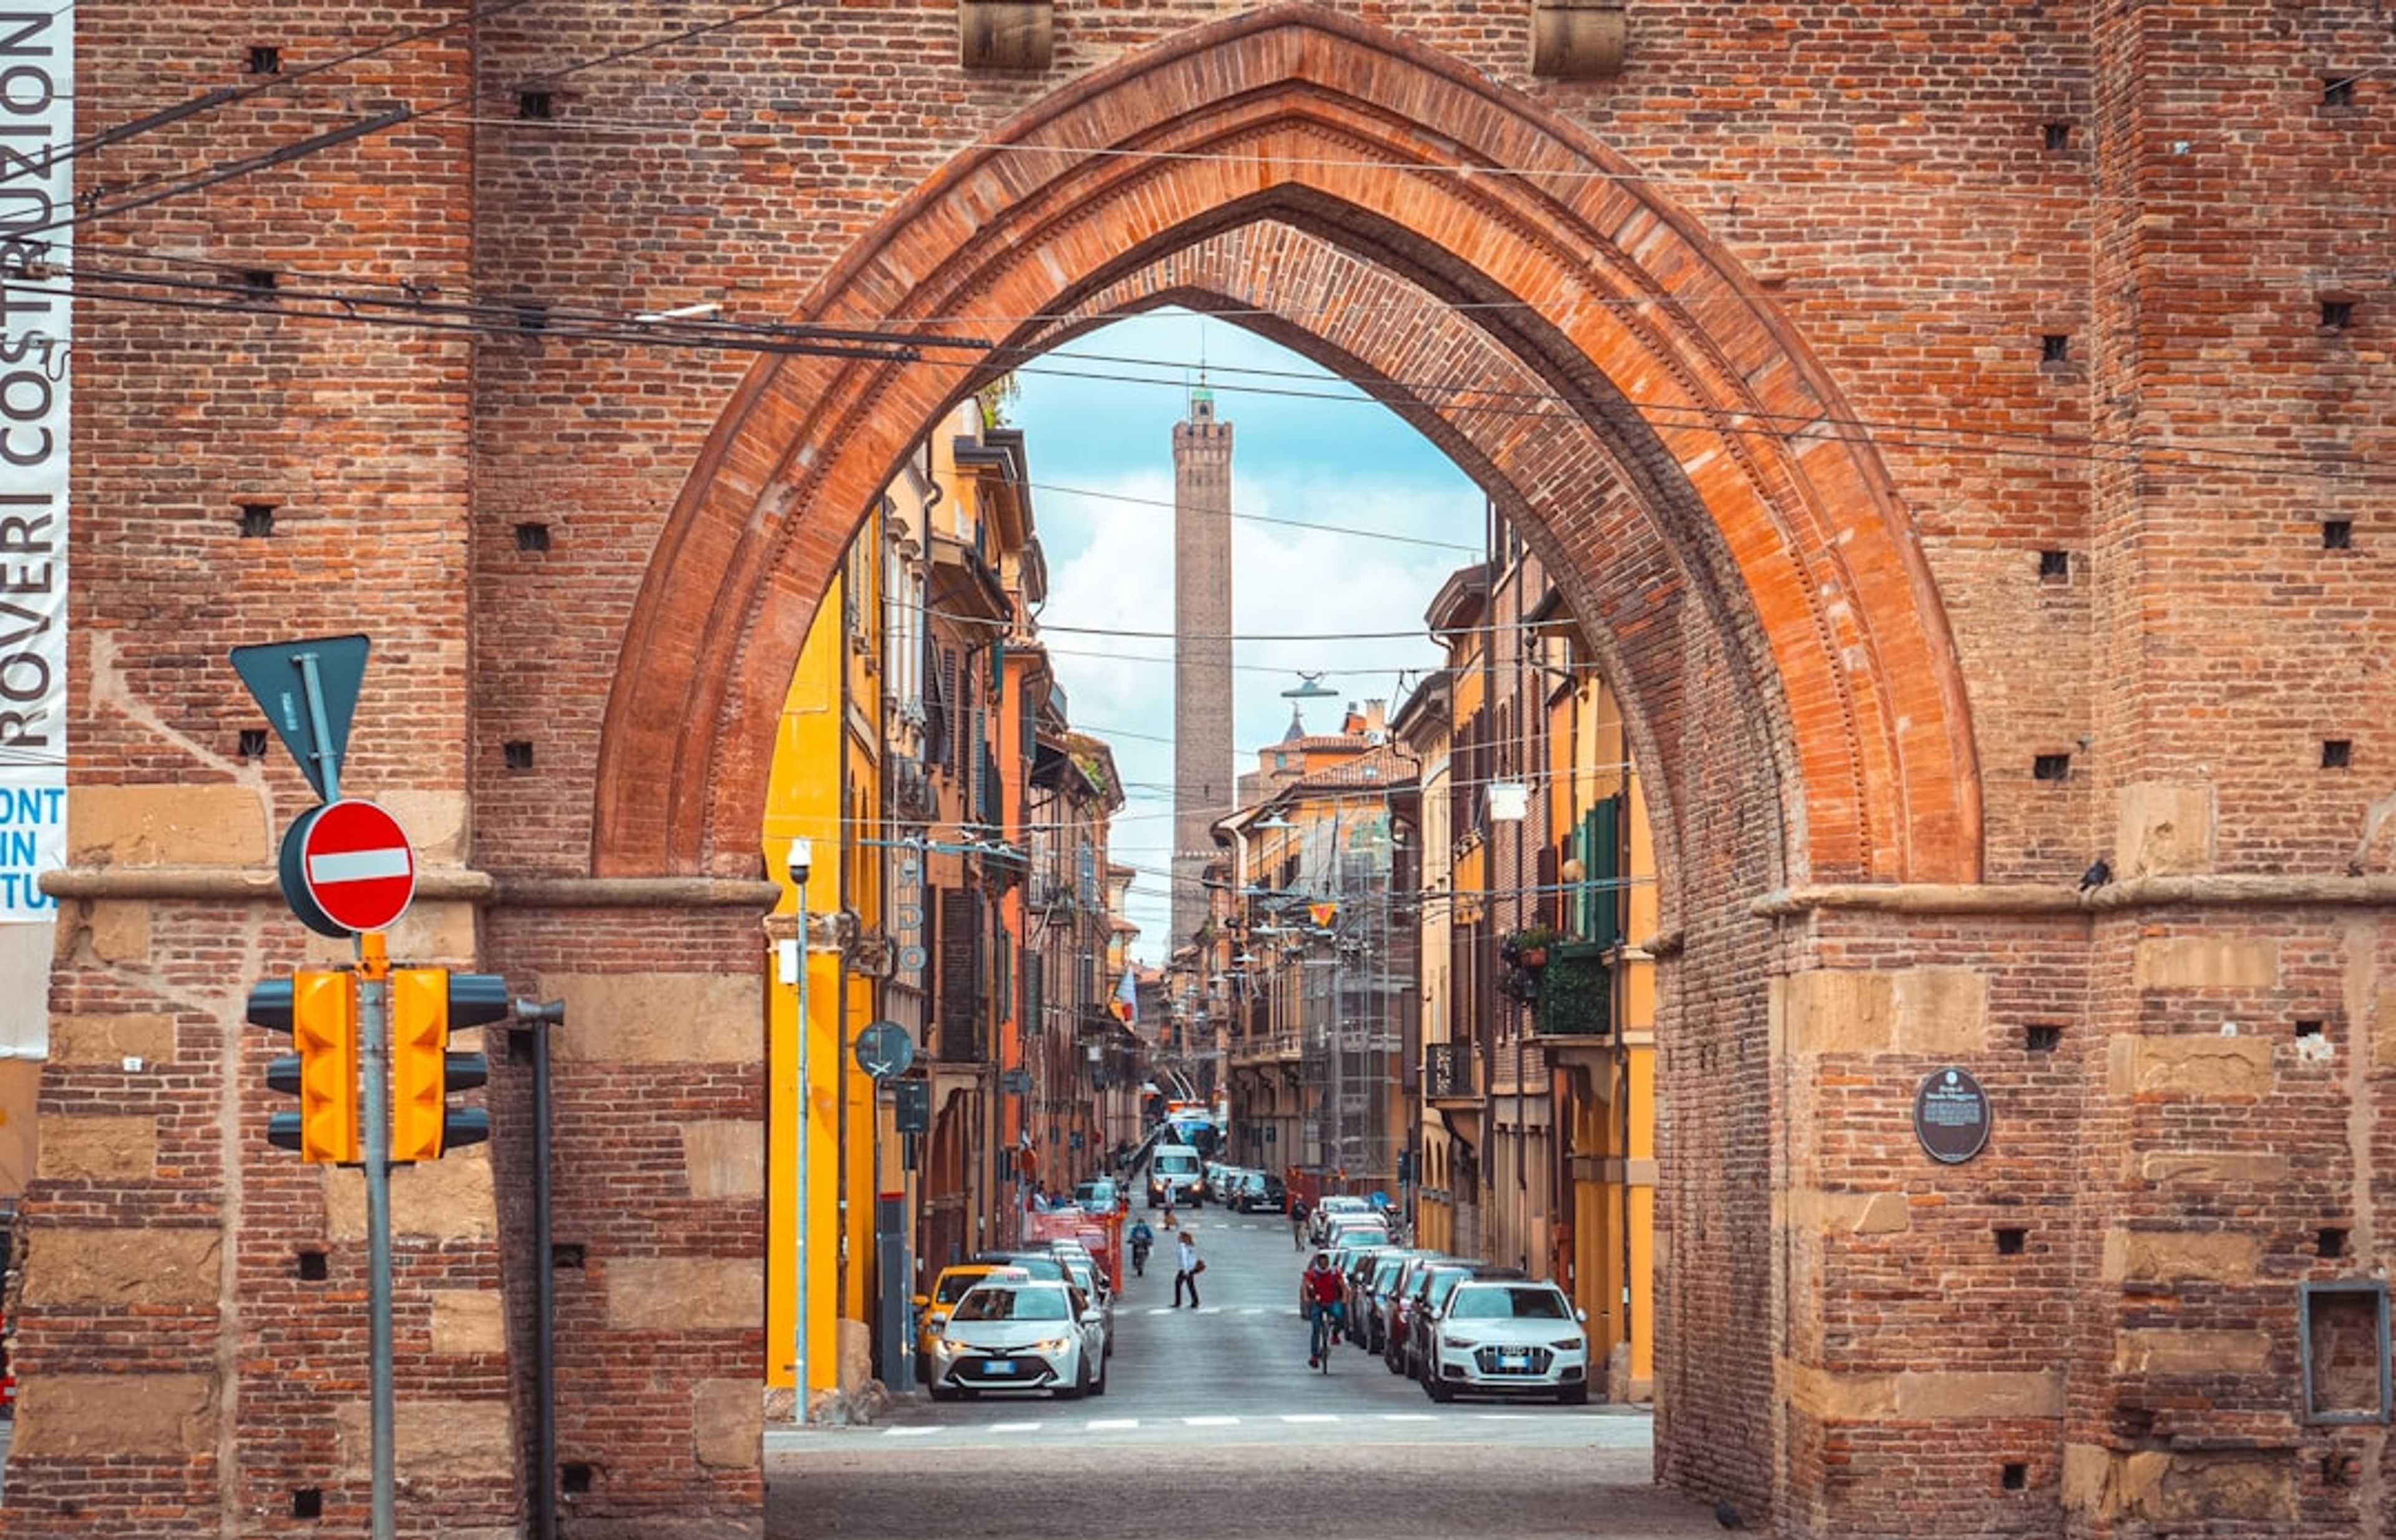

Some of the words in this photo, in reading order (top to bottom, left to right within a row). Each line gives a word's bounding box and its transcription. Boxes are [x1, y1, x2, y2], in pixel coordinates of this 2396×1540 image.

[0, 12, 52, 466] COSTRUZION
[0, 495, 52, 746] ROVERI
[0, 831, 36, 867] IN
[0, 873, 59, 909] TU
